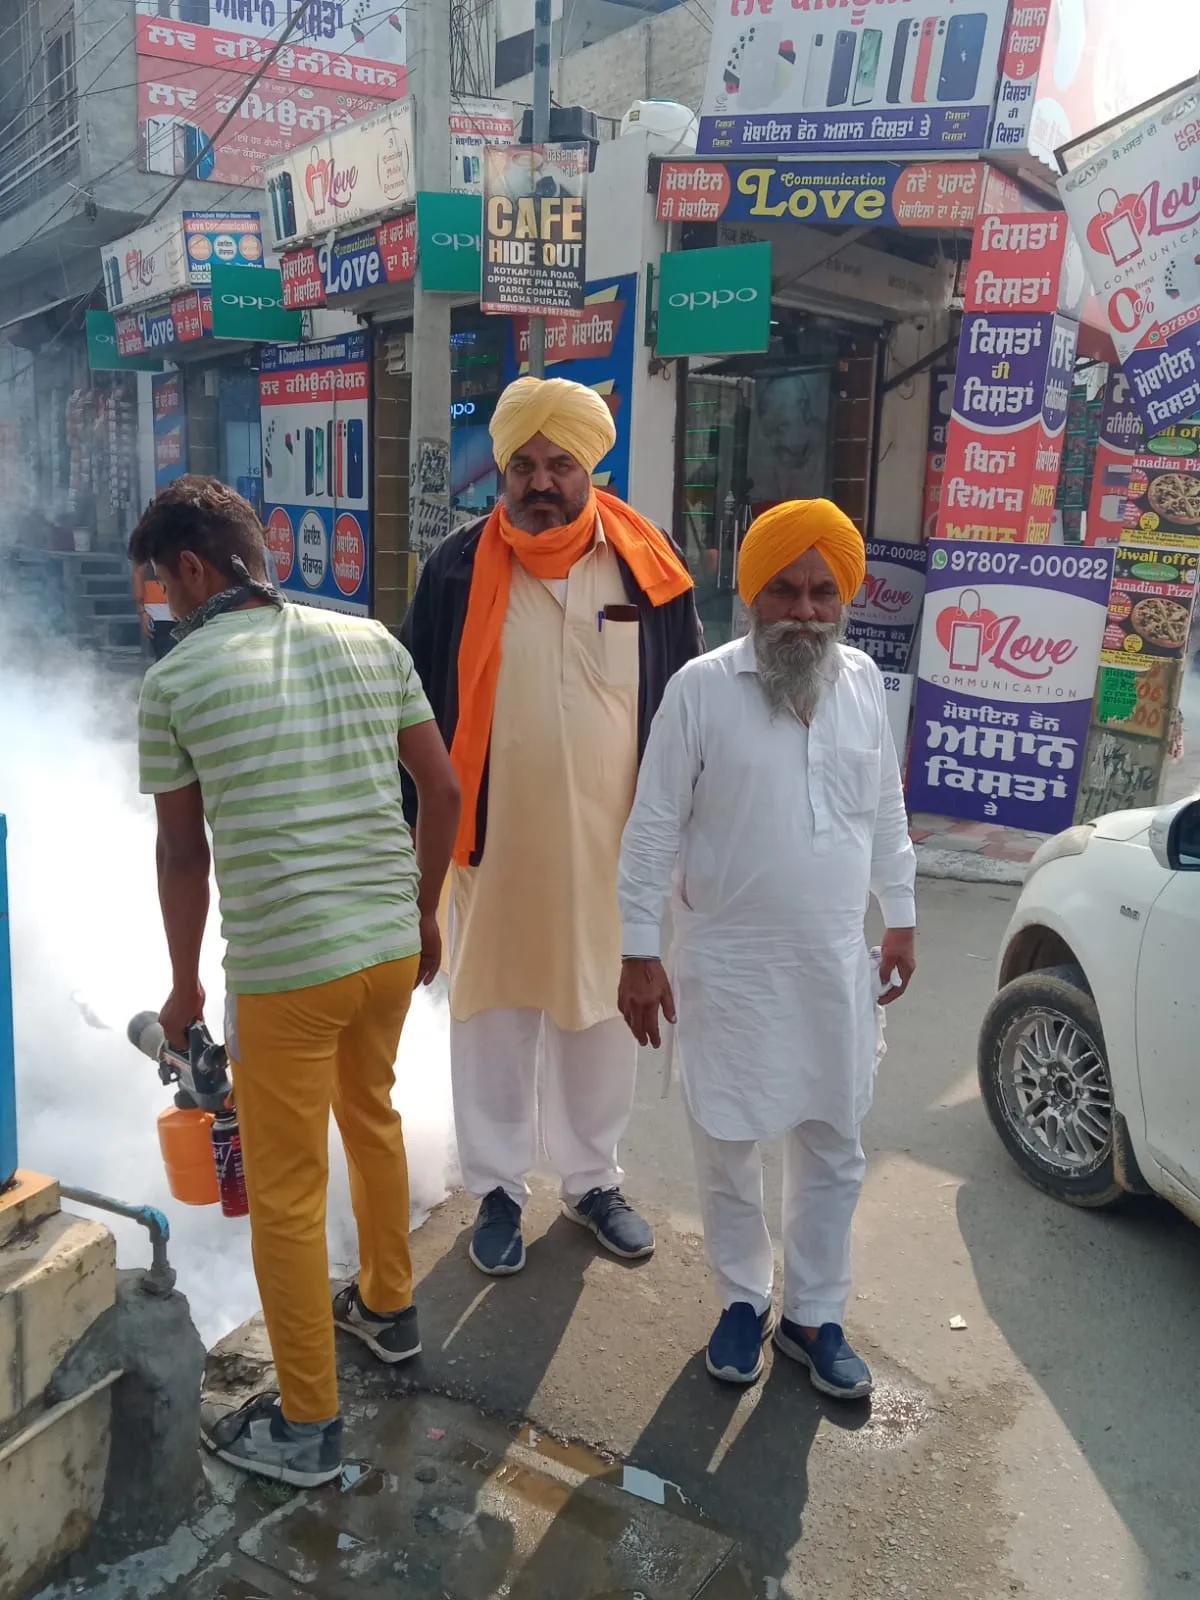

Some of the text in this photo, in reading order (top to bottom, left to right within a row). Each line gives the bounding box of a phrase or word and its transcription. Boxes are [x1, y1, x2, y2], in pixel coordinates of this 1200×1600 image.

[147, 24, 197, 50] ਲਵ
[146, 82, 198, 110] ਲਵ
[743, 120, 793, 142] ਮੋਬਾਇਲ
[797, 118, 818, 140] ਫੋਨ
[823, 122, 864, 139] ਅਸਾਨ
[919, 114, 932, 137] ਤੇ
[1174, 120, 1200, 142] HO
[327, 158, 358, 208] Love
[666, 166, 723, 191] ਮੋਬਾਇਲ
[781, 172, 886, 188] Communication
[906, 167, 932, 192] ਨਵੇਂ
[937, 167, 977, 199] ਪੁਰਾਣੇ
[662, 197, 720, 218] ਹੀ ਮੋਬਾਇਲ
[737, 168, 885, 219] Love
[1134, 175, 1200, 236] Lov
[487, 195, 583, 240] CAFE
[937, 205, 948, 218] ਦਾ
[335, 235, 377, 256] Communication
[432, 233, 480, 250] op
[981, 216, 1059, 254] ਕਿਸ਼ਤਾਂ
[488, 239, 582, 268] HIDE OUT
[1104, 228, 1199, 290] COMMUNICA
[318, 243, 380, 293] Love
[494, 267, 576, 280] KOTKAPURA ROAD,
[487, 275, 532, 286] OPPOSITE
[556, 280, 582, 290] BANK,
[526, 287, 571, 298] COMPLEX,
[975, 270, 1051, 308] ਕਿਸ਼ਤਾਂ
[500, 294, 570, 307] BAGHA PURANA
[668, 287, 757, 311] oppo
[138, 312, 174, 347] Love
[969, 318, 1042, 359] ਕਿਸ਼ਤਾਂ
[991, 360, 1010, 379] ਹੀ
[1133, 347, 1195, 398] ਮੋਬਾਇਲ
[260, 381, 279, 395] ਲਵ
[963, 376, 1034, 416] ਕਿਸ਼ਤਾਂ
[964, 441, 1016, 474] ਬਿਨਾਂ
[866, 543, 926, 562] 807-00022
[951, 551, 1107, 580] 97807-00022
[1163, 552, 1198, 567] offe
[869, 578, 912, 613] Love
[1110, 604, 1132, 614] REE
[985, 615, 1078, 679] Love
[884, 677, 900, 691] 22
[931, 674, 1077, 698] COMMUNICATION
[944, 701, 1060, 731] ਮੋਬਾਇਲ ਫੋਨ
[926, 720, 1079, 769] ਅਸਾਨ
[925, 755, 1068, 801] ਕਿਸ਼ਤਾਂ
[984, 801, 998, 816] ਤੇ
